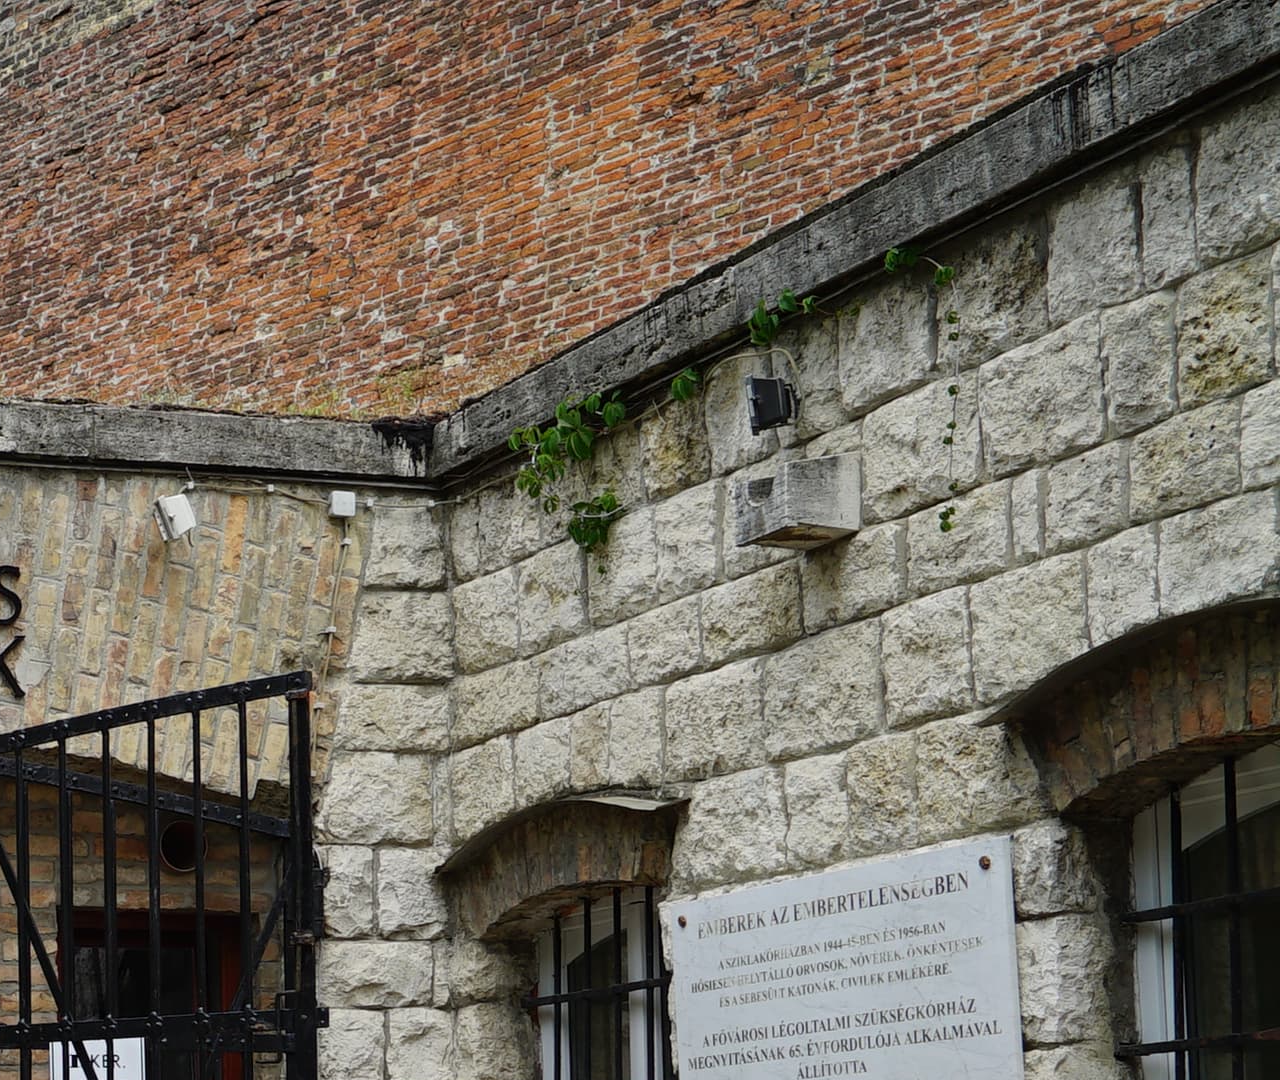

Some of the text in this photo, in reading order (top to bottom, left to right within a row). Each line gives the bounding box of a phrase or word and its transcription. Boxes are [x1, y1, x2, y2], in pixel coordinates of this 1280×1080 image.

[698, 871, 969, 939] EMBEREK AZ EMBERTELENSÉGBEN
[883, 928, 896, 943] ÉS
[899, 920, 946, 940] 1956-BAN
[732, 995, 739, 1006] A
[841, 973, 885, 989] CIVILEK
[688, 1019, 1002, 1071] MEGNYITÁSÁNAK 65. ÉVFORDULÓJA ALKALMÁVAL
[703, 1034, 710, 1048] A
[772, 1014, 850, 1039] LÉGOLTALMI
[797, 1060, 868, 1080] ÁLLÍTOTTA
